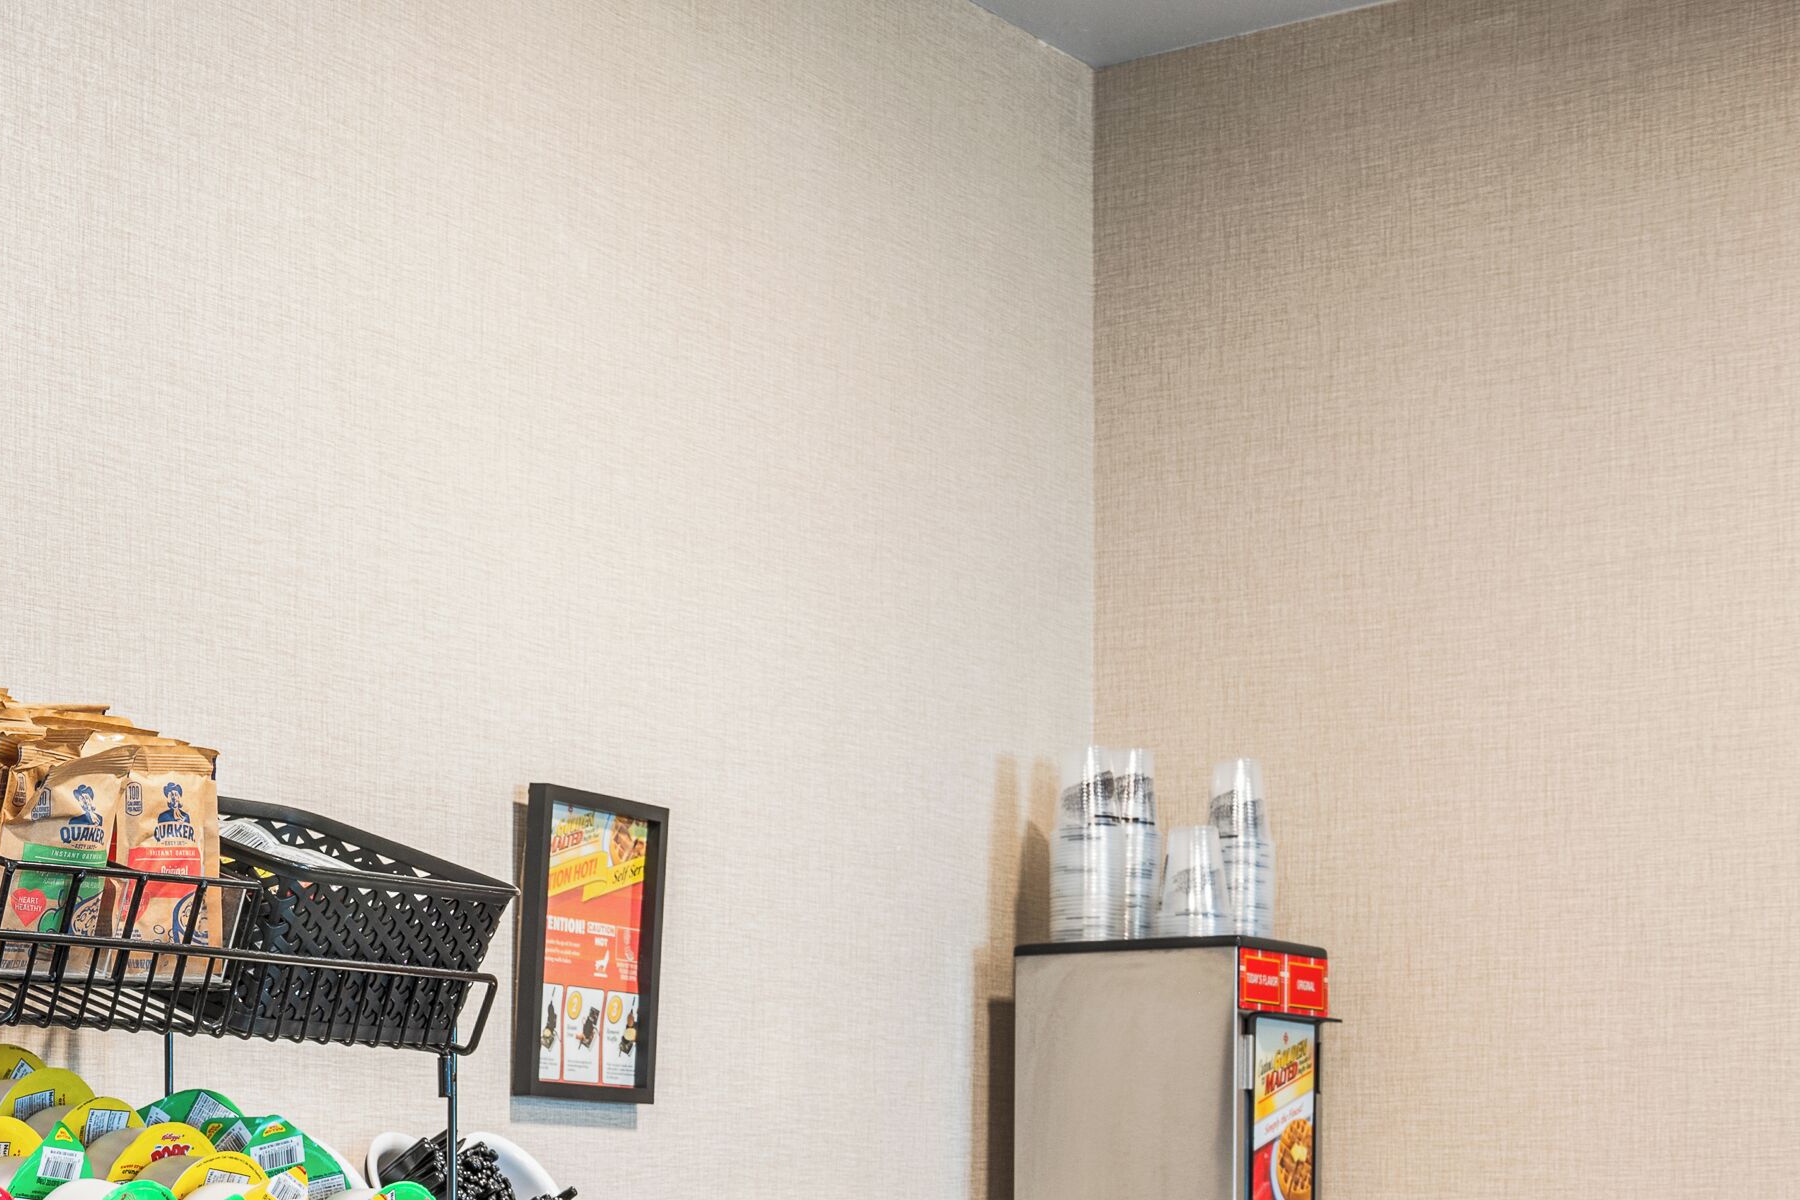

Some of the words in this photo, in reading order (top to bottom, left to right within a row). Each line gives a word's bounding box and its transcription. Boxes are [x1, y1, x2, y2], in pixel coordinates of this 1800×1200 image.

[128, 784, 140, 800] 100
[60, 825, 105, 846] QUAKER
[153, 824, 195, 843] QUAKER
[51, 850, 80, 859] INSTANT
[160, 864, 189, 876] Original
[574, 858, 598, 879] HOT!
[15, 903, 43, 912] HEALTHY
[19, 896, 39, 905] HEART
[1264, 1060, 1299, 1096] MALTED
